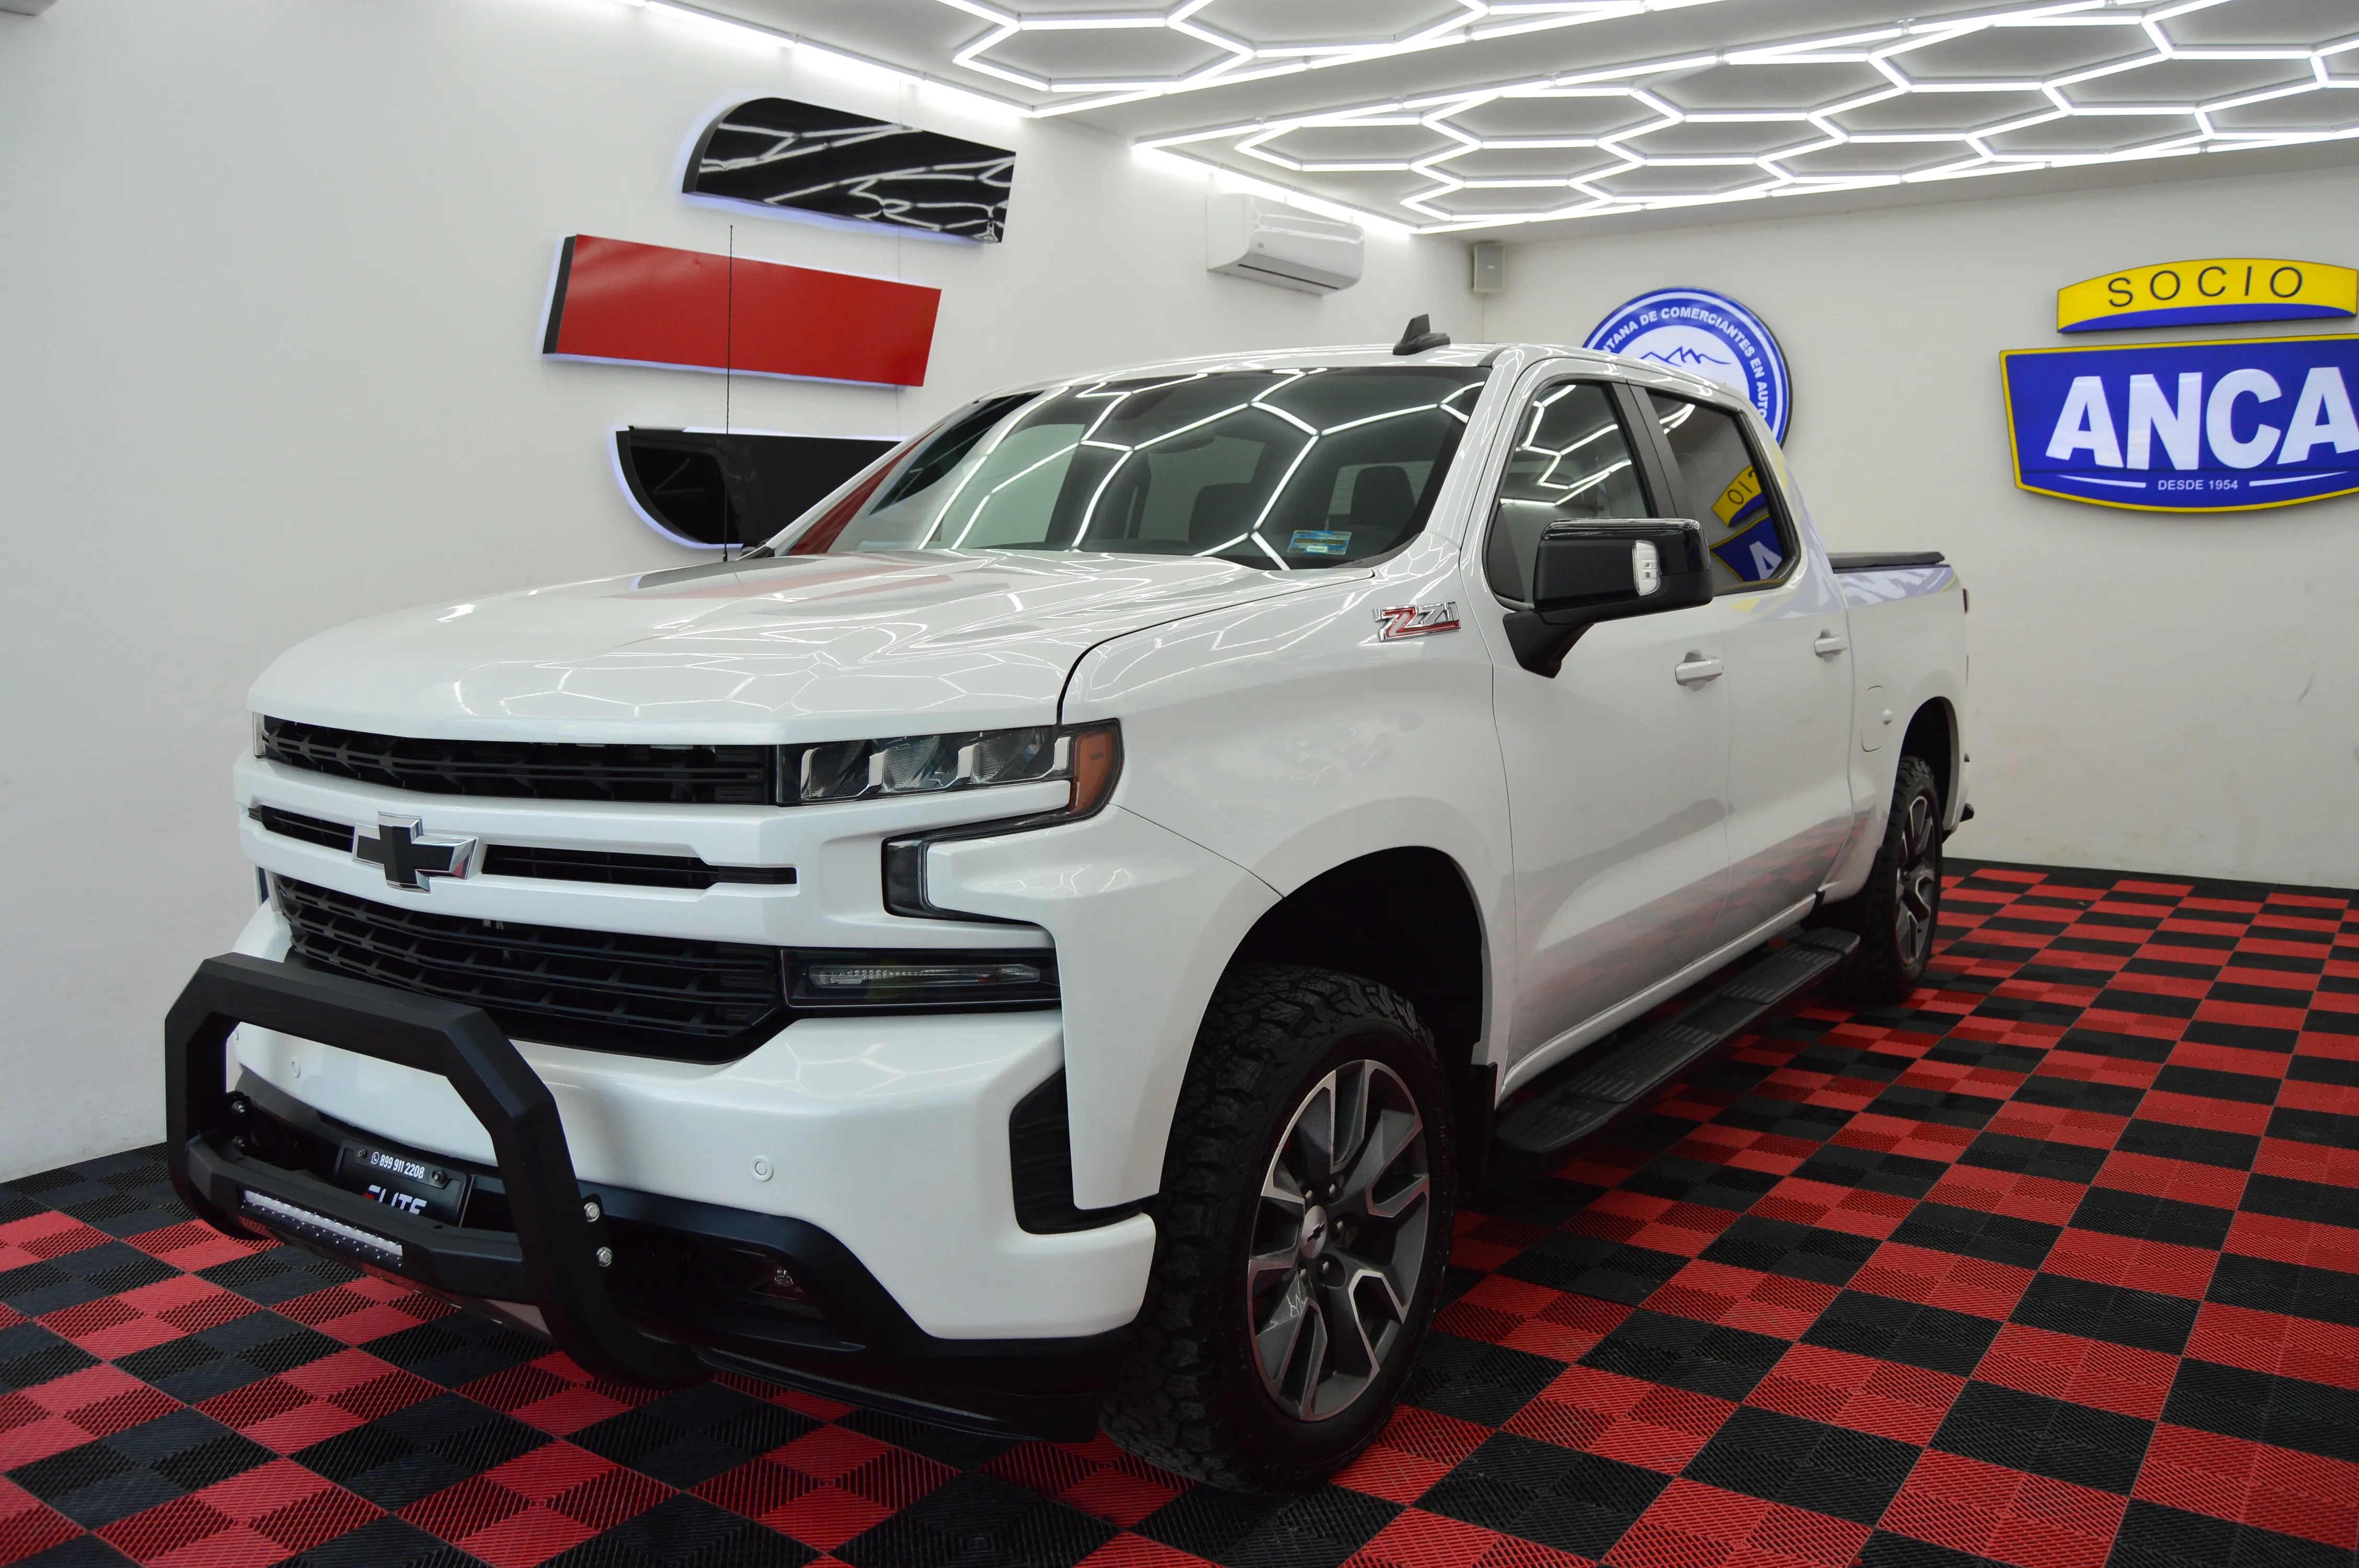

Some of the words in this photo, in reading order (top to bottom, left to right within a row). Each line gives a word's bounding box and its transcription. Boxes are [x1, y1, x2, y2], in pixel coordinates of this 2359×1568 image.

[2108, 266, 2302, 307] SOCIO
[1640, 310, 1658, 326] DE
[1661, 307, 1755, 358] COMERCIANTES
[1750, 357, 1765, 378] EN
[2045, 367, 2359, 470] ANCA
[2158, 479, 2204, 490] DESDE
[2208, 479, 2238, 490] 1954
[1372, 602, 1461, 642] Z71
[380, 1154, 393, 1169] 899
[393, 1158, 405, 1173] 911
[405, 1162, 425, 1179] 2208
